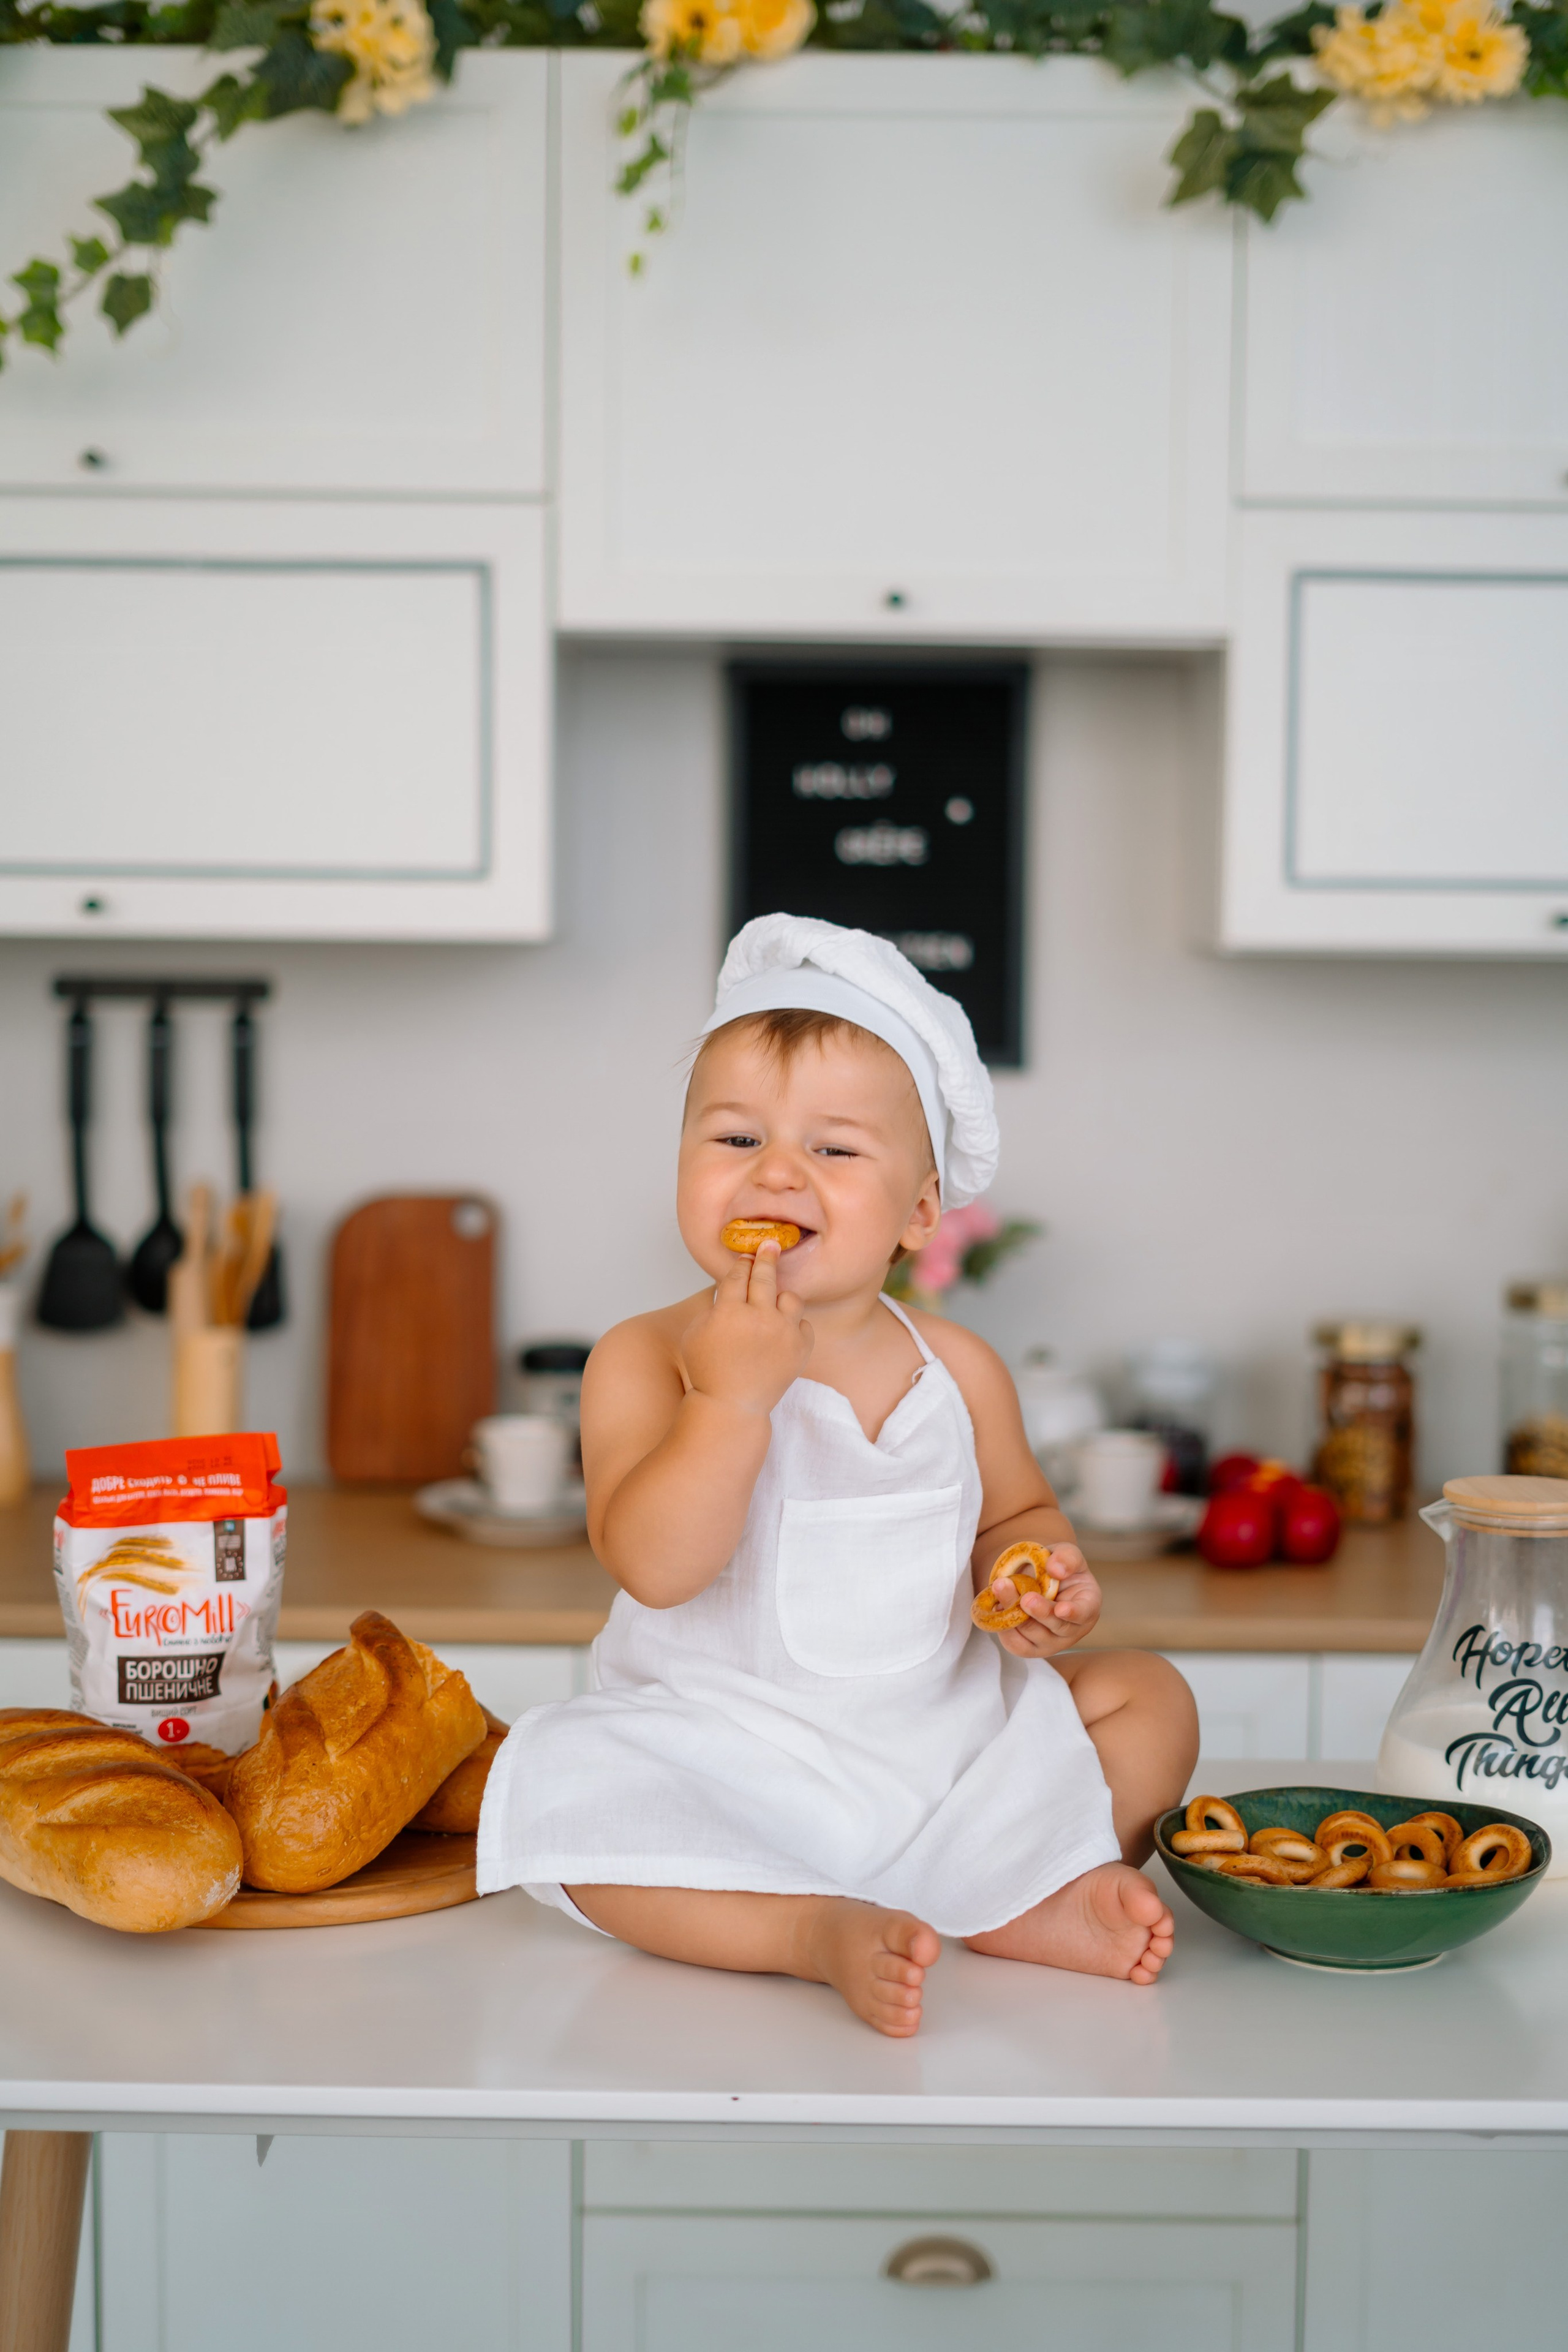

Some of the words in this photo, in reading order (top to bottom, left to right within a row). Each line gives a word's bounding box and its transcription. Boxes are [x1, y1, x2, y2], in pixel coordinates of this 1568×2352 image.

[126, 1657, 218, 1680] БОРОШНО
[126, 1676, 214, 1700] ПШЕНИЧНЕ
[1445, 1732, 1568, 1791] Thing
